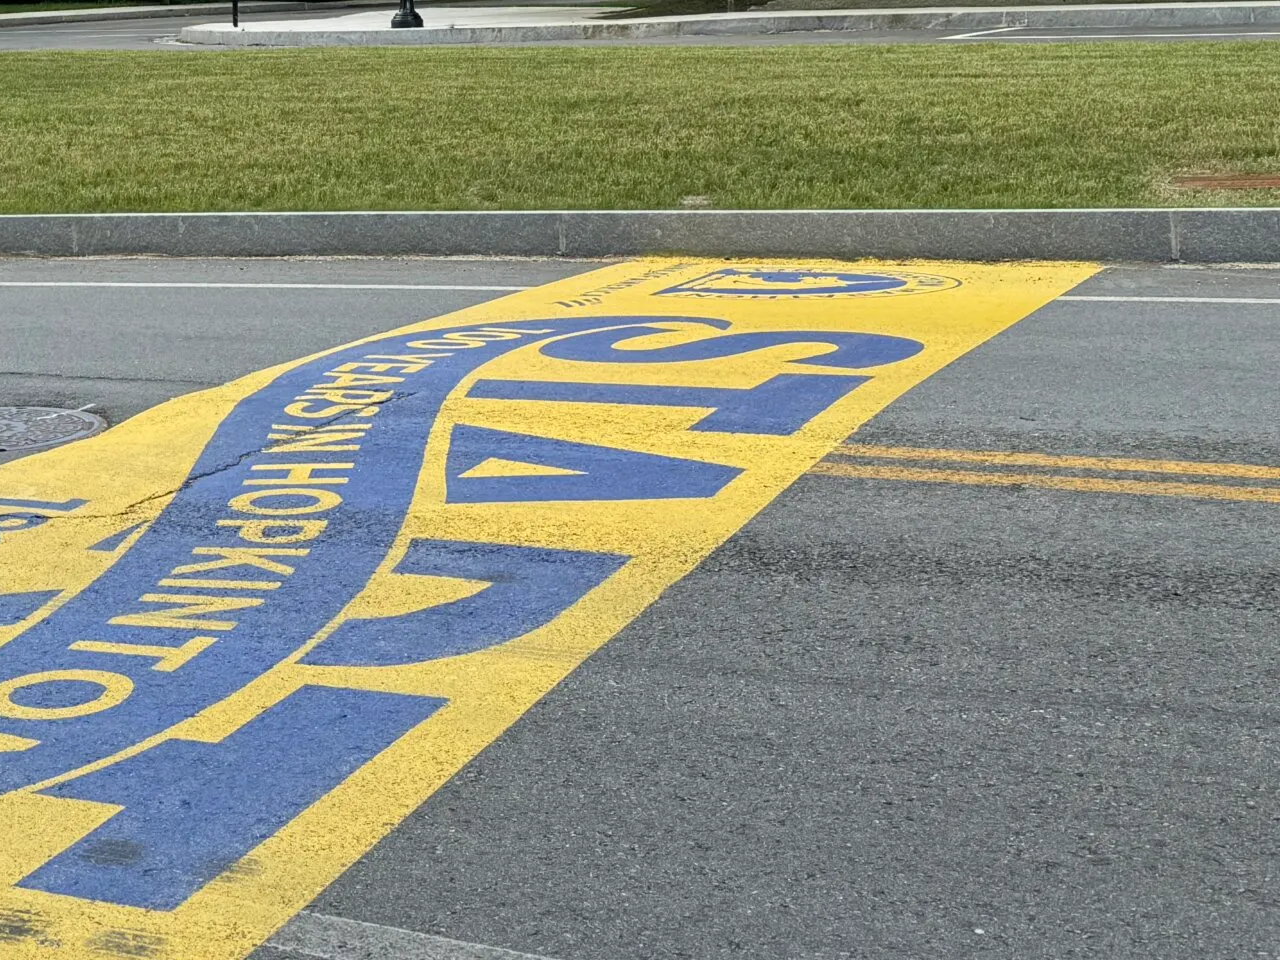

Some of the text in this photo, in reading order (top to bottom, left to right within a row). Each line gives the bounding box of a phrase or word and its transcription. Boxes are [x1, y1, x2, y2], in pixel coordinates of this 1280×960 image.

[406, 327, 556, 349] 100
[284, 352, 455, 418] YEARS
[261, 423, 373, 453] IN
